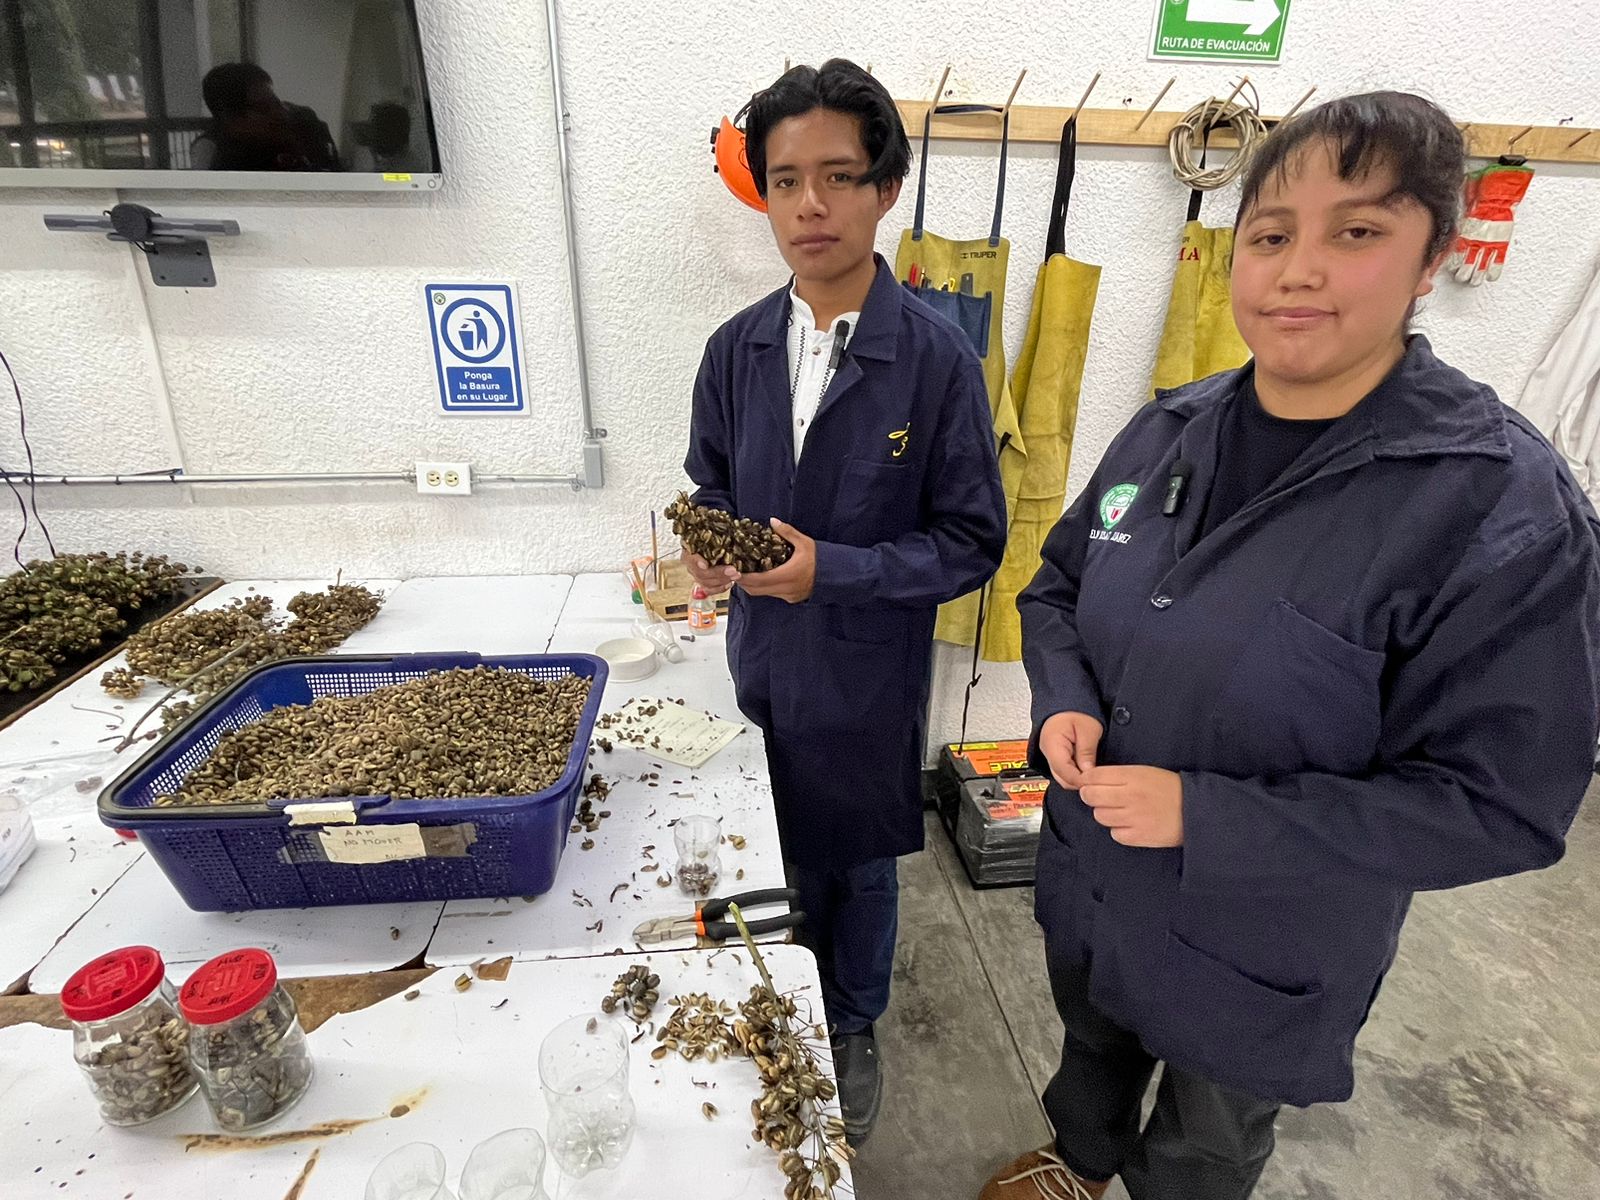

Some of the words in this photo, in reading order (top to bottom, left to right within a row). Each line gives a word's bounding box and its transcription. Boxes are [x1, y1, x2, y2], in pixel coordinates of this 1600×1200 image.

[1162, 36, 1189, 48] RUTA
[1190, 38, 1205, 49] DE
[1206, 38, 1270, 52] EVACUACIÓN
[970, 251, 997, 259] TRUPER
[464, 371, 493, 381] Ponga
[459, 382, 468, 390] la
[469, 382, 500, 390] Basura
[482, 393, 508, 402] Lugar
